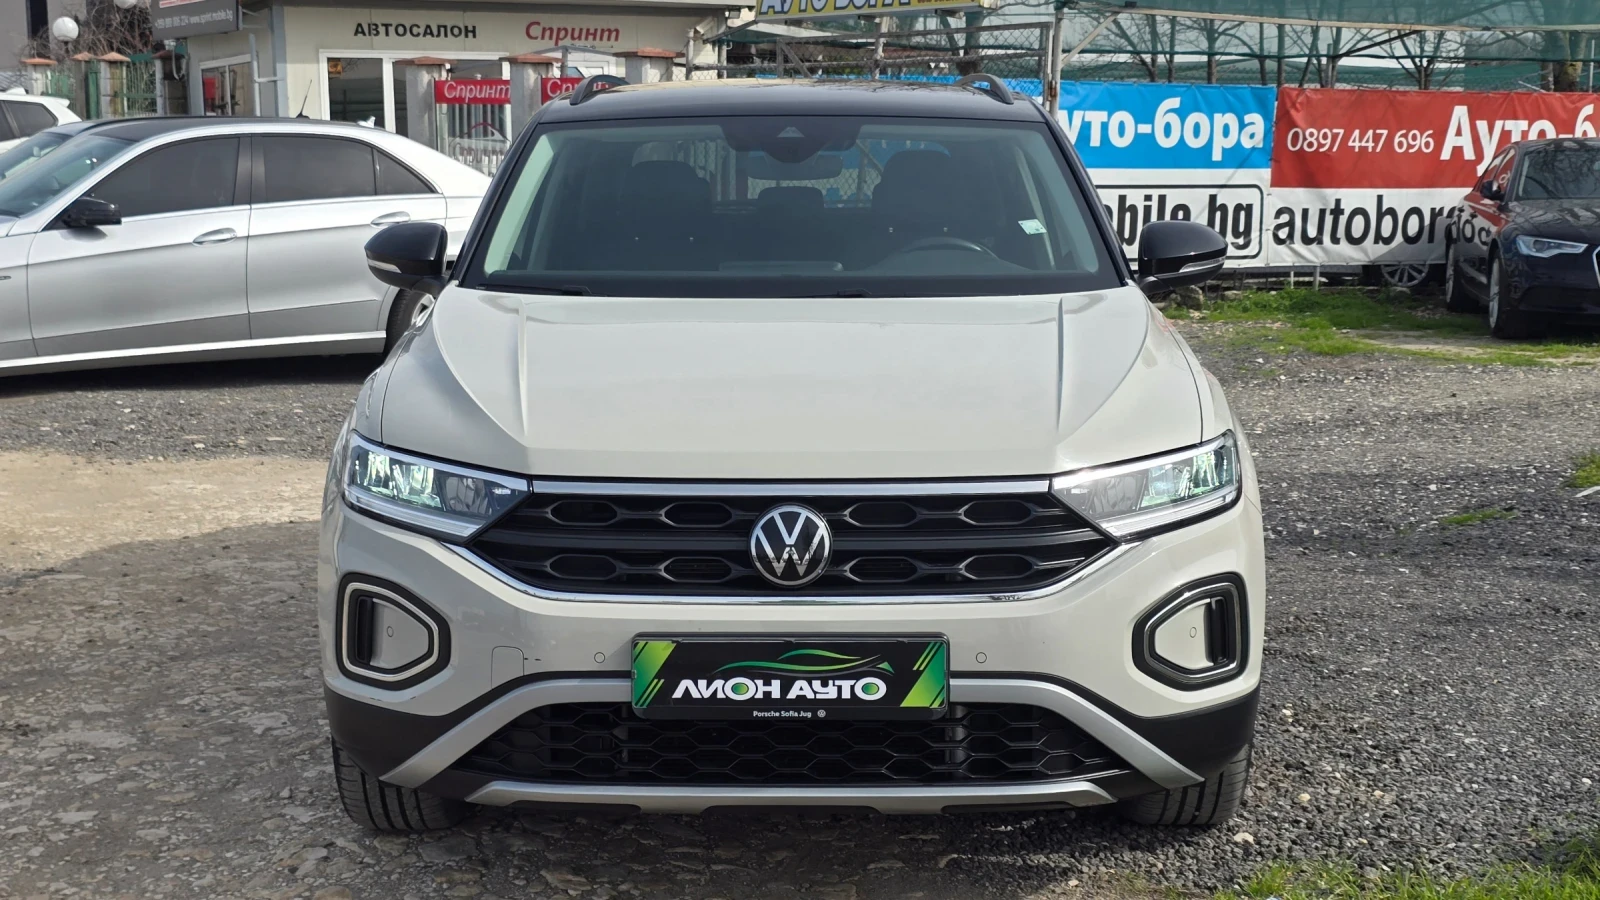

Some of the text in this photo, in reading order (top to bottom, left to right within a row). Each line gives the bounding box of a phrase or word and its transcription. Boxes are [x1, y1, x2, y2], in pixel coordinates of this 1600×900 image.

[354, 23, 477, 39] АВТОСАЛОН
[525, 21, 620, 46] Спринт
[444, 81, 511, 103] Спринт
[1058, 97, 1265, 161] уто-бора
[1287, 128, 1344, 152] 0897
[1348, 129, 1388, 152] 447
[1393, 129, 1435, 153] 696
[672, 677, 887, 701] ЛИОН АУТО
